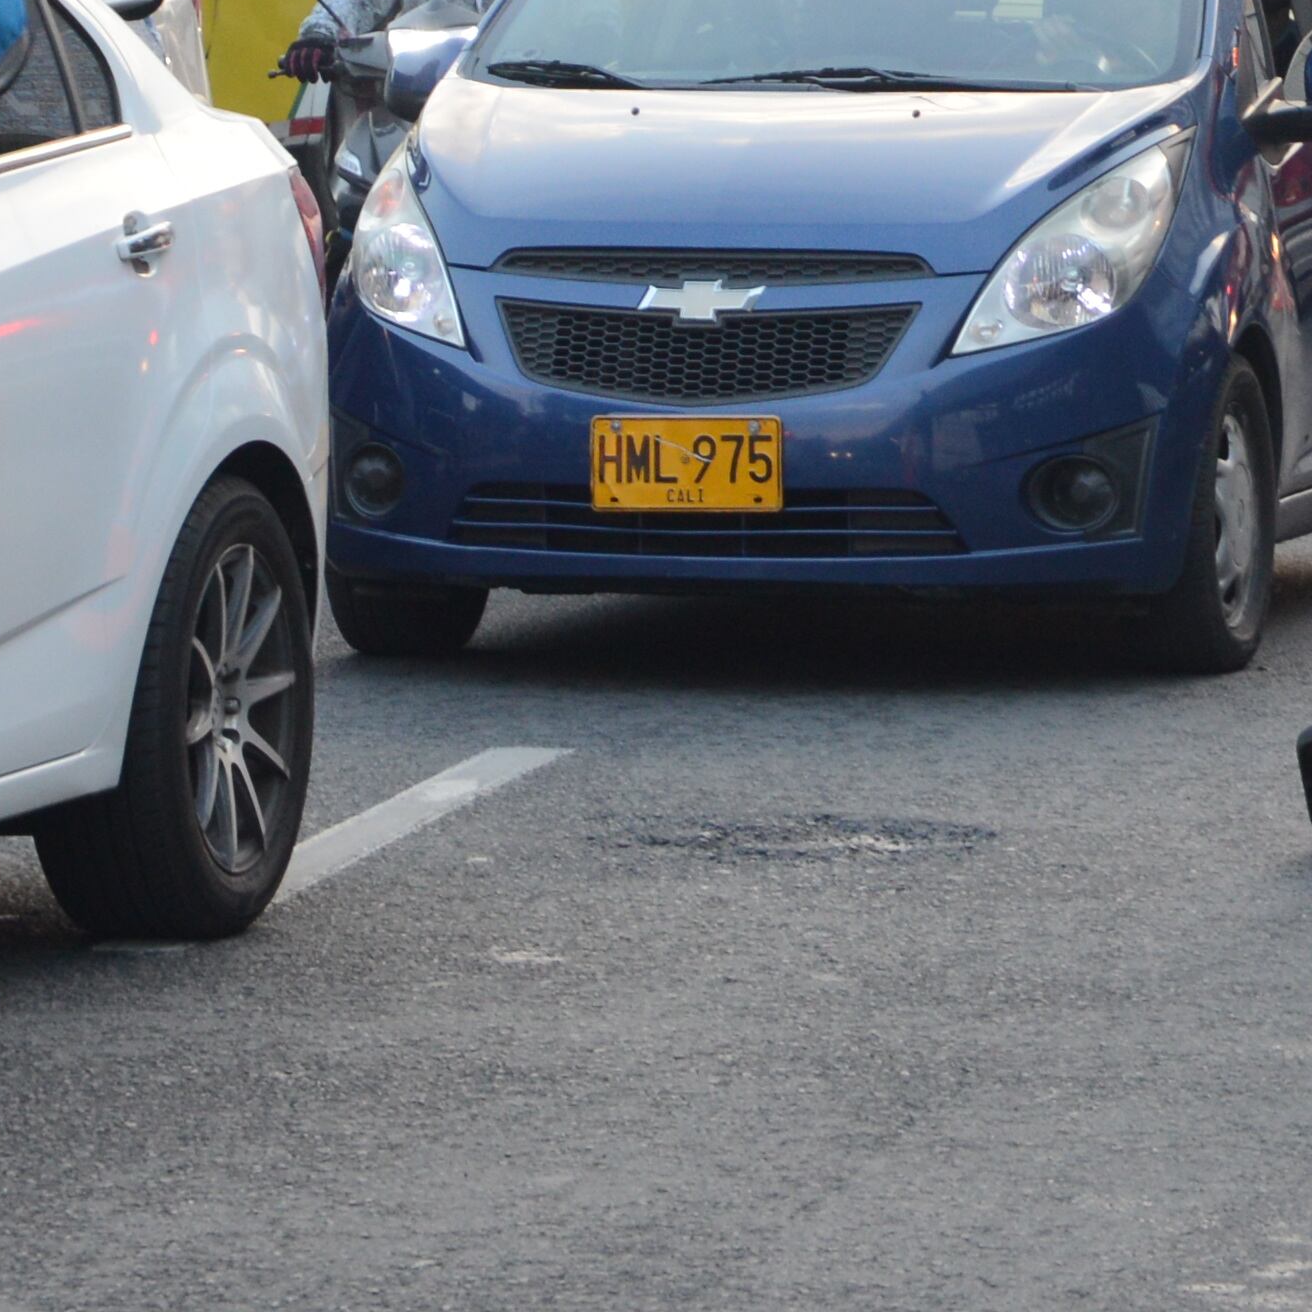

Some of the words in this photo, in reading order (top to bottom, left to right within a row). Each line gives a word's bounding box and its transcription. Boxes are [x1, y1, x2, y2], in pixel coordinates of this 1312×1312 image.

[598, 435, 678, 484] HML
[691, 435, 773, 484] 975
[666, 489, 704, 503] CALI
